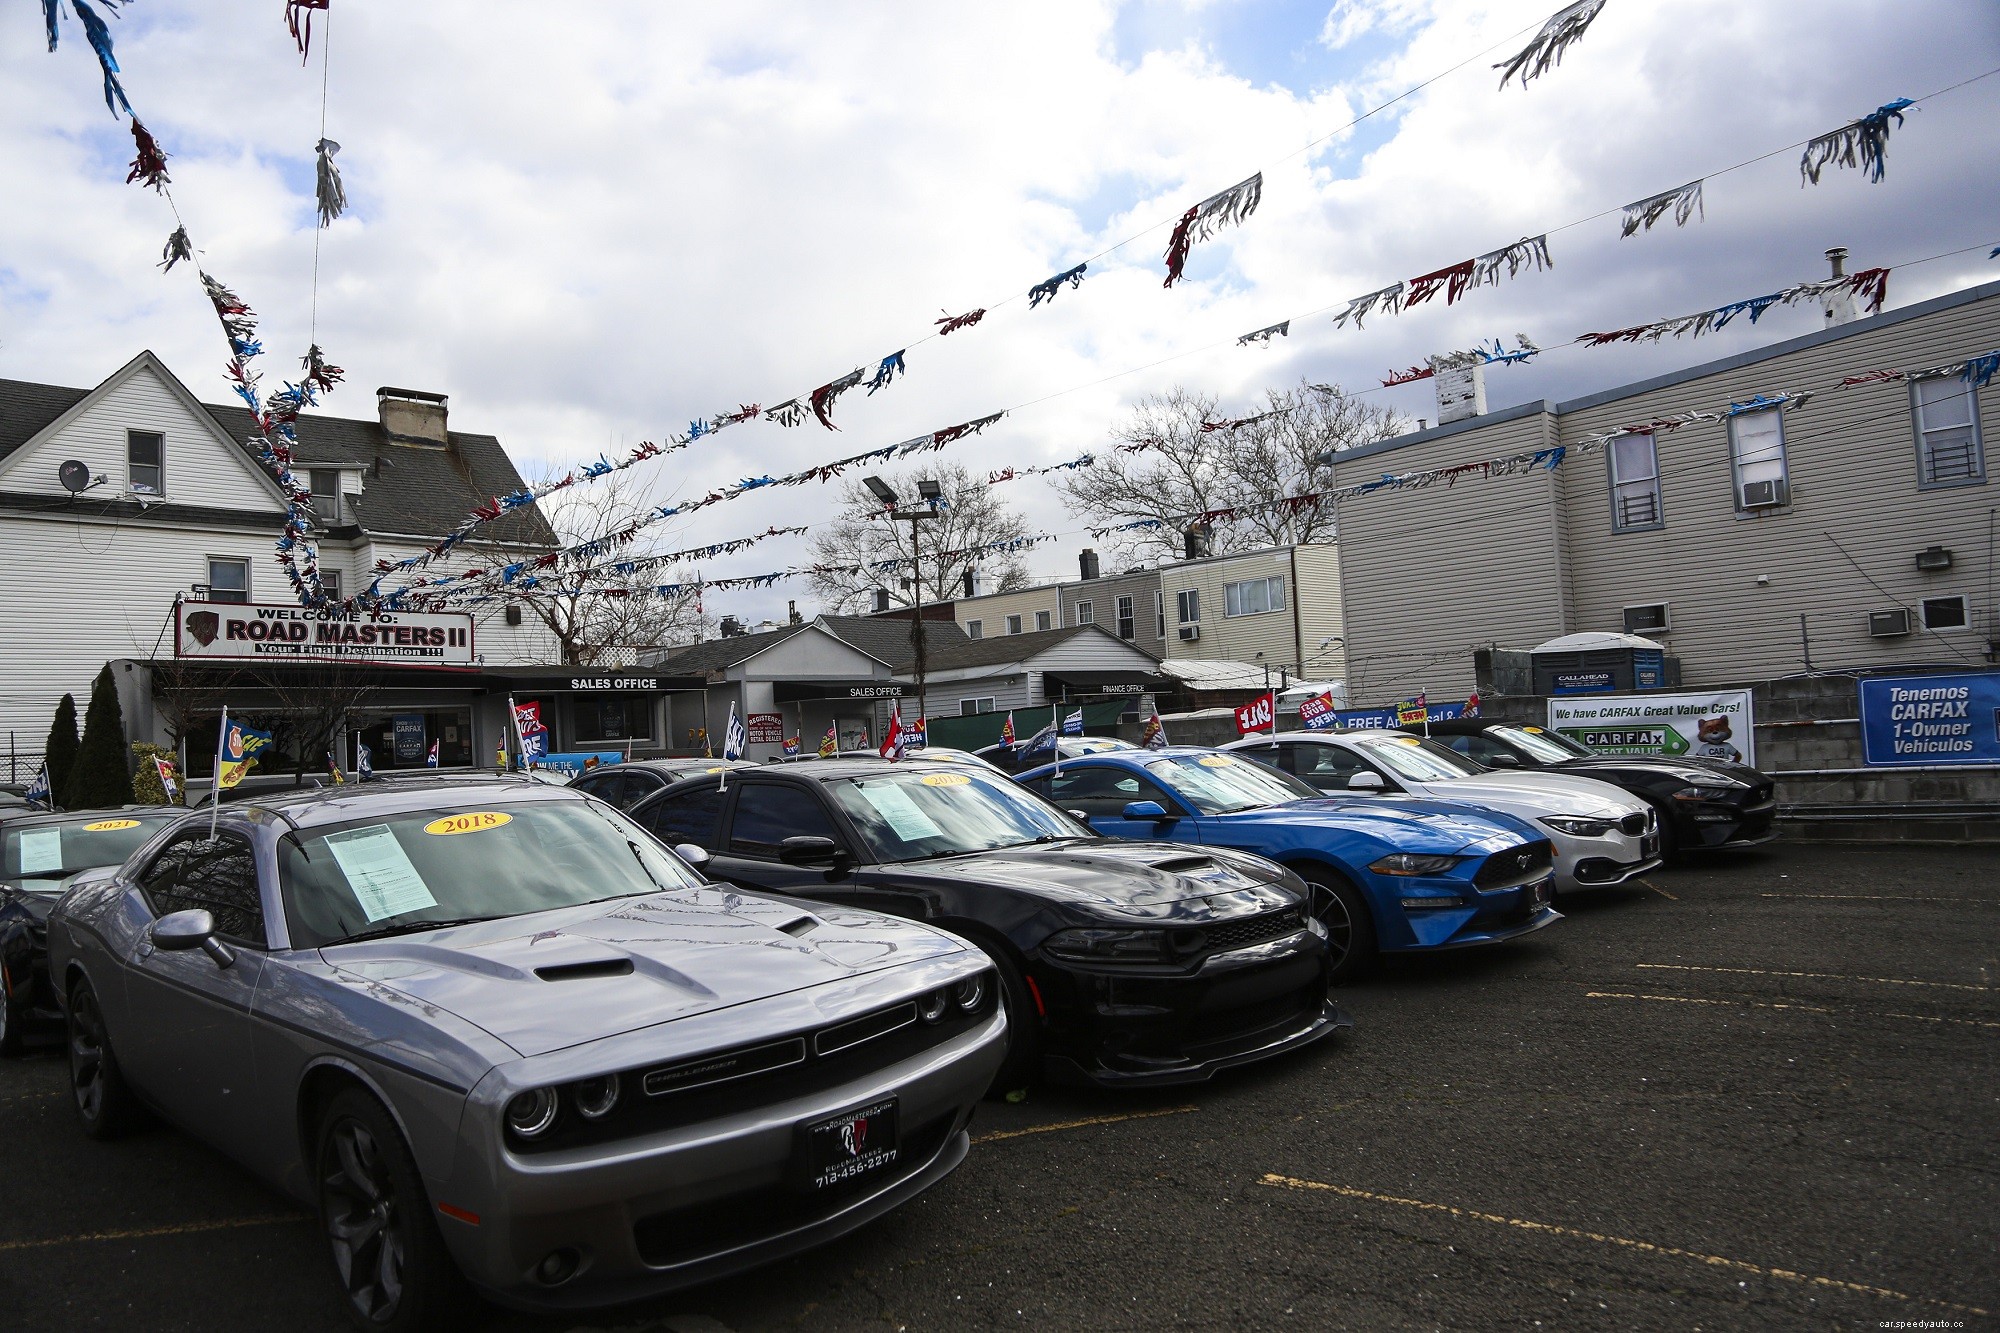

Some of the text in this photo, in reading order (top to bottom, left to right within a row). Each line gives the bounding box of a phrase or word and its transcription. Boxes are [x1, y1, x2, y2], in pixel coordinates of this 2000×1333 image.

[256, 608, 398, 624] WELCOME TO:
[226, 619, 309, 642] ROAD
[316, 623, 446, 646] MASTERS
[449, 628, 466, 647] II
[259, 643, 295, 656] Your
[345, 646, 421, 657] Destination
[1558, 673, 1609, 681] CALLAHEAD
[571, 678, 657, 689] SALES OFFICE
[1102, 684, 1145, 693] FINANCE OFFICE
[850, 686, 902, 697] SALES OFFICE
[1890, 686, 1969, 702] Tenemos
[1556, 702, 1741, 719] We have CARFAX Great Value Cars!
[1891, 701, 1969, 721] CARFAX
[748, 715, 782, 726] REGISTERED
[1347, 717, 1383, 729] FREE
[396, 725, 422, 733] CARFAX
[1893, 721, 1971, 738] 1-Owner
[1586, 732, 1664, 745] CARFAX
[1709, 748, 1725, 756] CAR
[560, 761, 573, 769] THE
[95, 820, 131, 830] 2021
[443, 813, 497, 833] 2018
[647, 1060, 737, 1084] CHALLENGER
